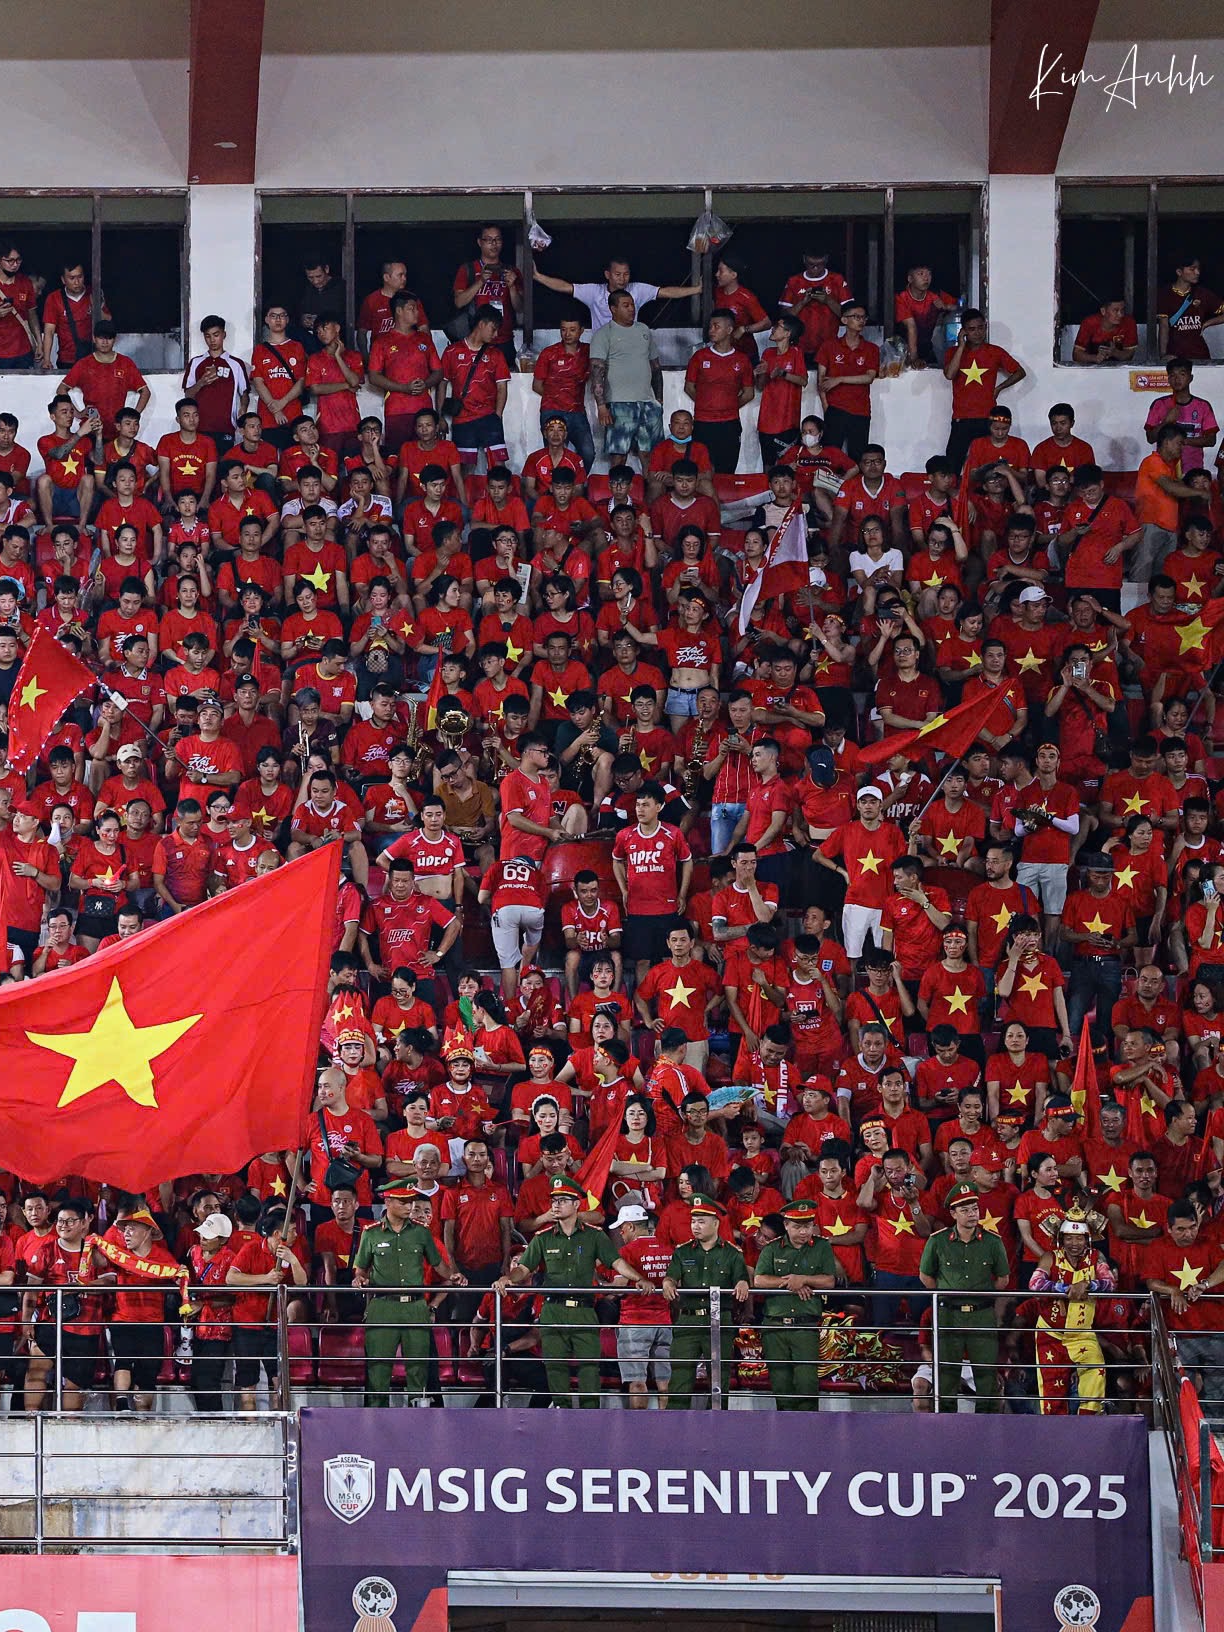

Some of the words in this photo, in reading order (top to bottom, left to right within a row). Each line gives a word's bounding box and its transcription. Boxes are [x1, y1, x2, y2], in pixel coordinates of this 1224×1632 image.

[1175, 315, 1202, 327] ATAR
[629, 851, 661, 865] HPFC
[503, 864, 531, 882] 69
[387, 928, 415, 943] HPFC
[136, 1259, 178, 1278] NAM
[386, 1468, 528, 1514] MSIG
[545, 1467, 832, 1515] SERENITY
[992, 1472, 1127, 1520] 2025
